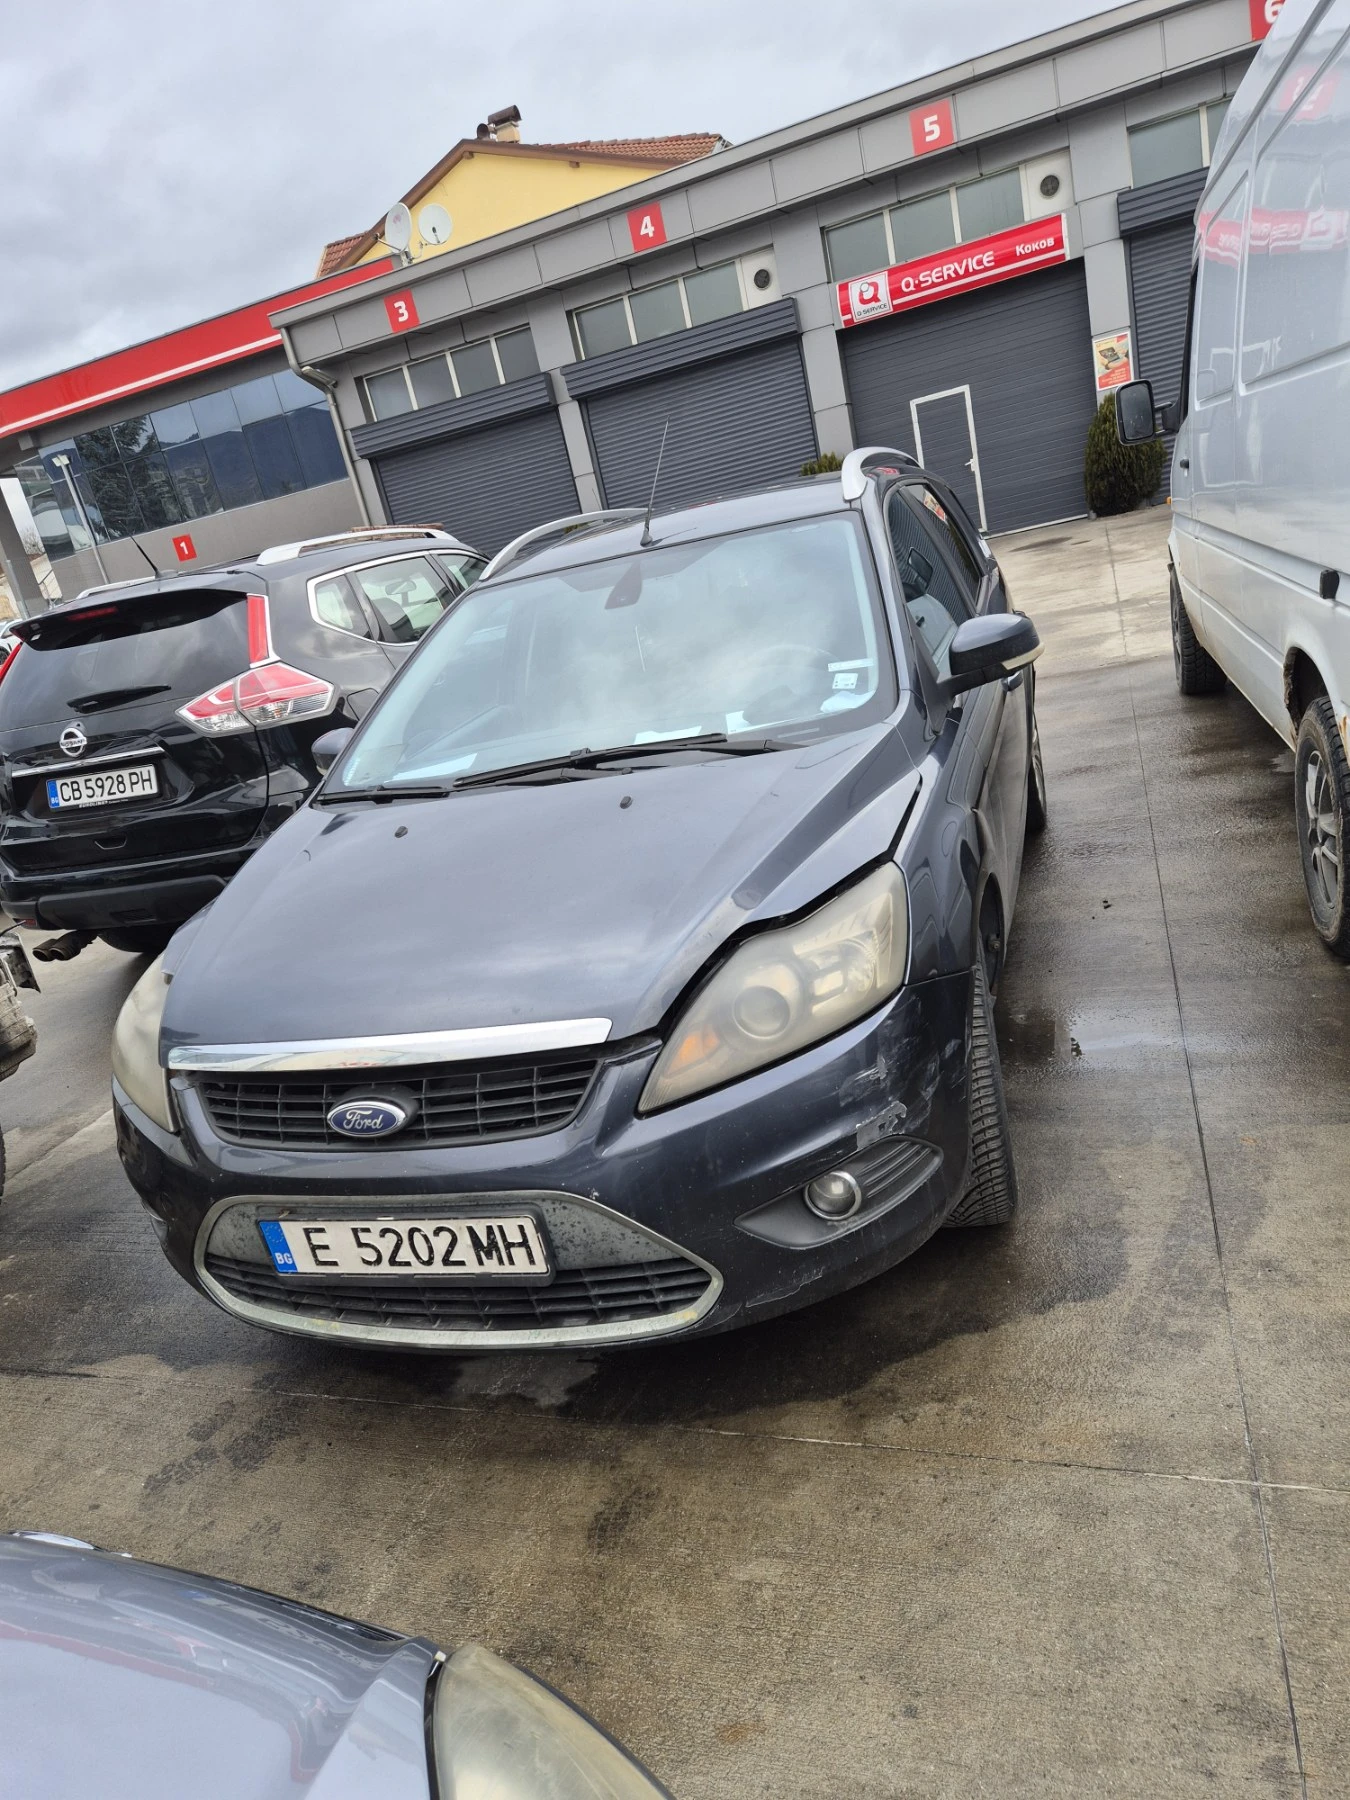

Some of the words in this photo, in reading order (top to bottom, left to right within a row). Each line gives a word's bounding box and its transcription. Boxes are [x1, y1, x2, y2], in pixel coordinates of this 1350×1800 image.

[923, 114, 941, 143] 5
[640, 215, 655, 238] 4
[1015, 237, 1055, 257] Коков
[393, 300, 409, 323] 3
[179, 541, 189, 555] 1
[59, 780, 83, 803] CB
[84, 774, 126, 798] 5928
[128, 769, 153, 793] PH
[343, 1109, 384, 1130] Ford
[275, 1252, 294, 1265] BG
[302, 1227, 340, 1267] E
